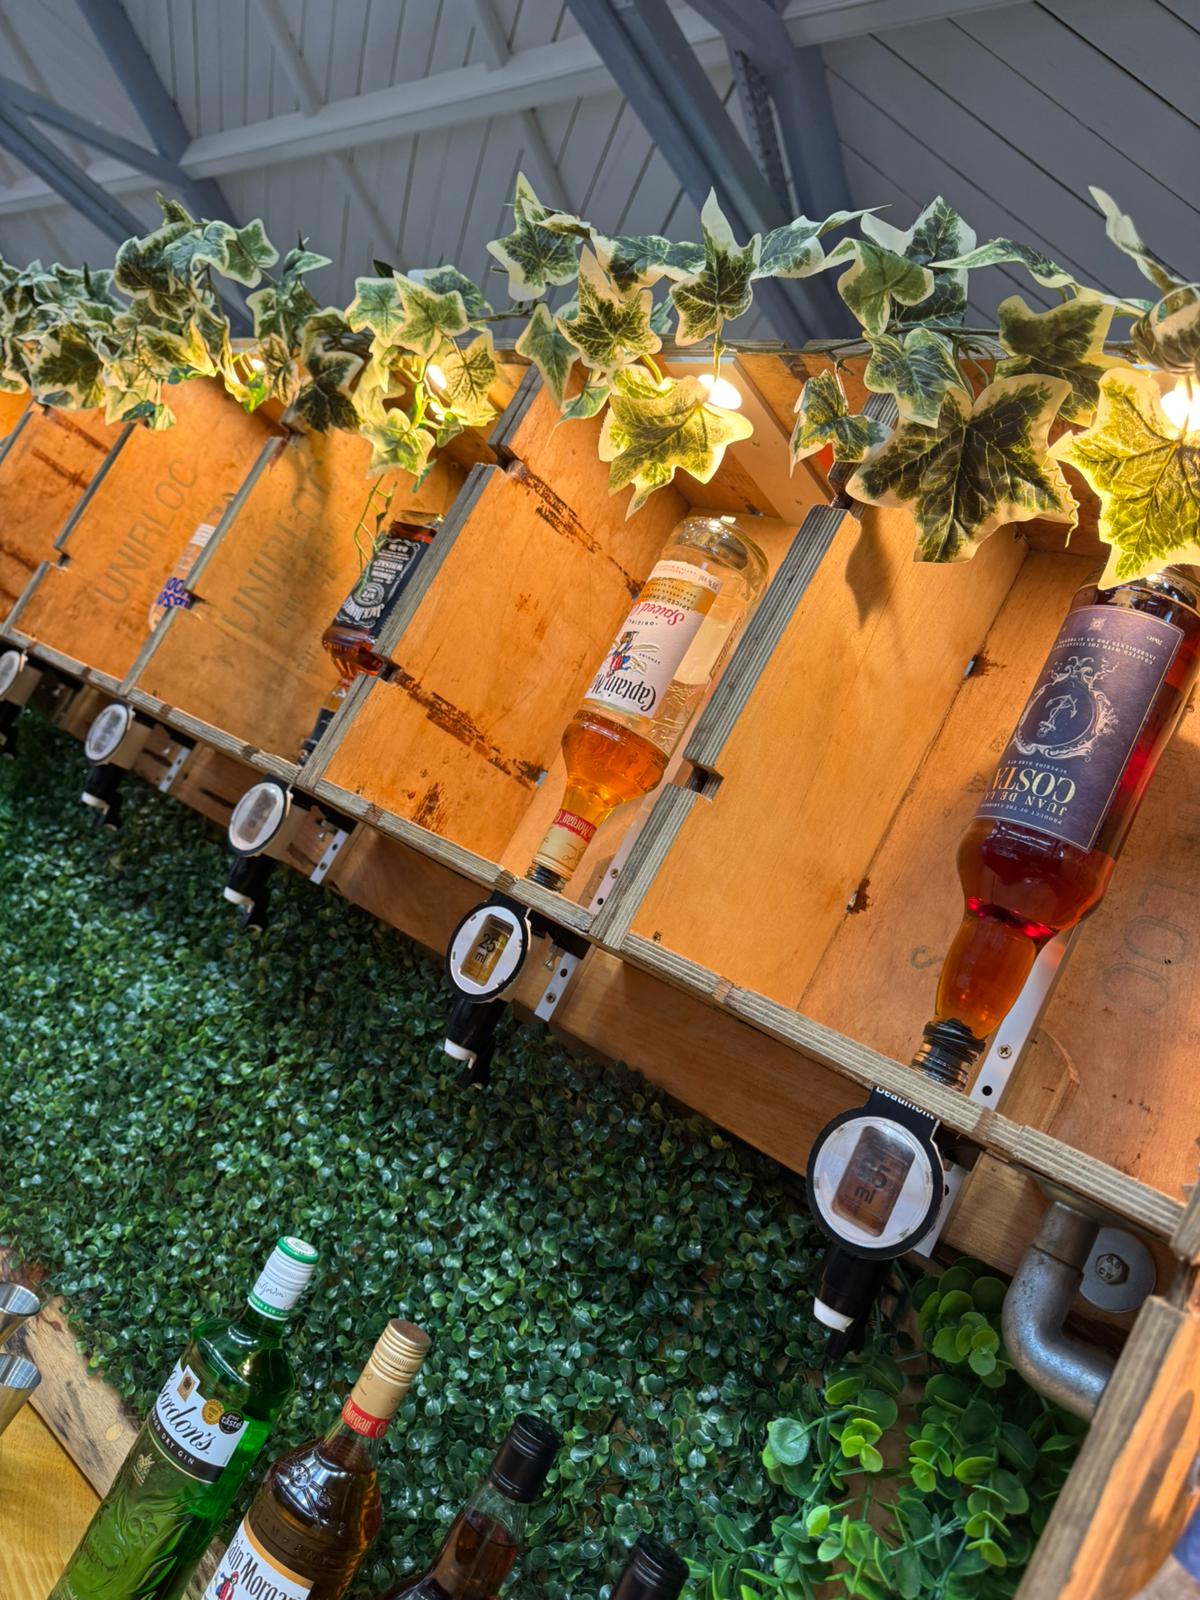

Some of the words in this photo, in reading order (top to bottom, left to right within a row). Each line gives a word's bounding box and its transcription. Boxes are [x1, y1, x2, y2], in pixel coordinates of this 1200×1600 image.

[637, 603, 684, 625] Spiced
[601, 676, 656, 711] Captain
[992, 767, 1076, 803] COSTA
[1001, 791, 1017, 801] DE
[1025, 795, 1066, 816] JUAN
[477, 932, 498, 953] 25
[474, 951, 488, 964] ml
[855, 1187, 876, 1203] ml
[160, 1432, 175, 1448] DRY
[176, 1450, 194, 1465] GIN
[240, 1552, 300, 1599] Mor
